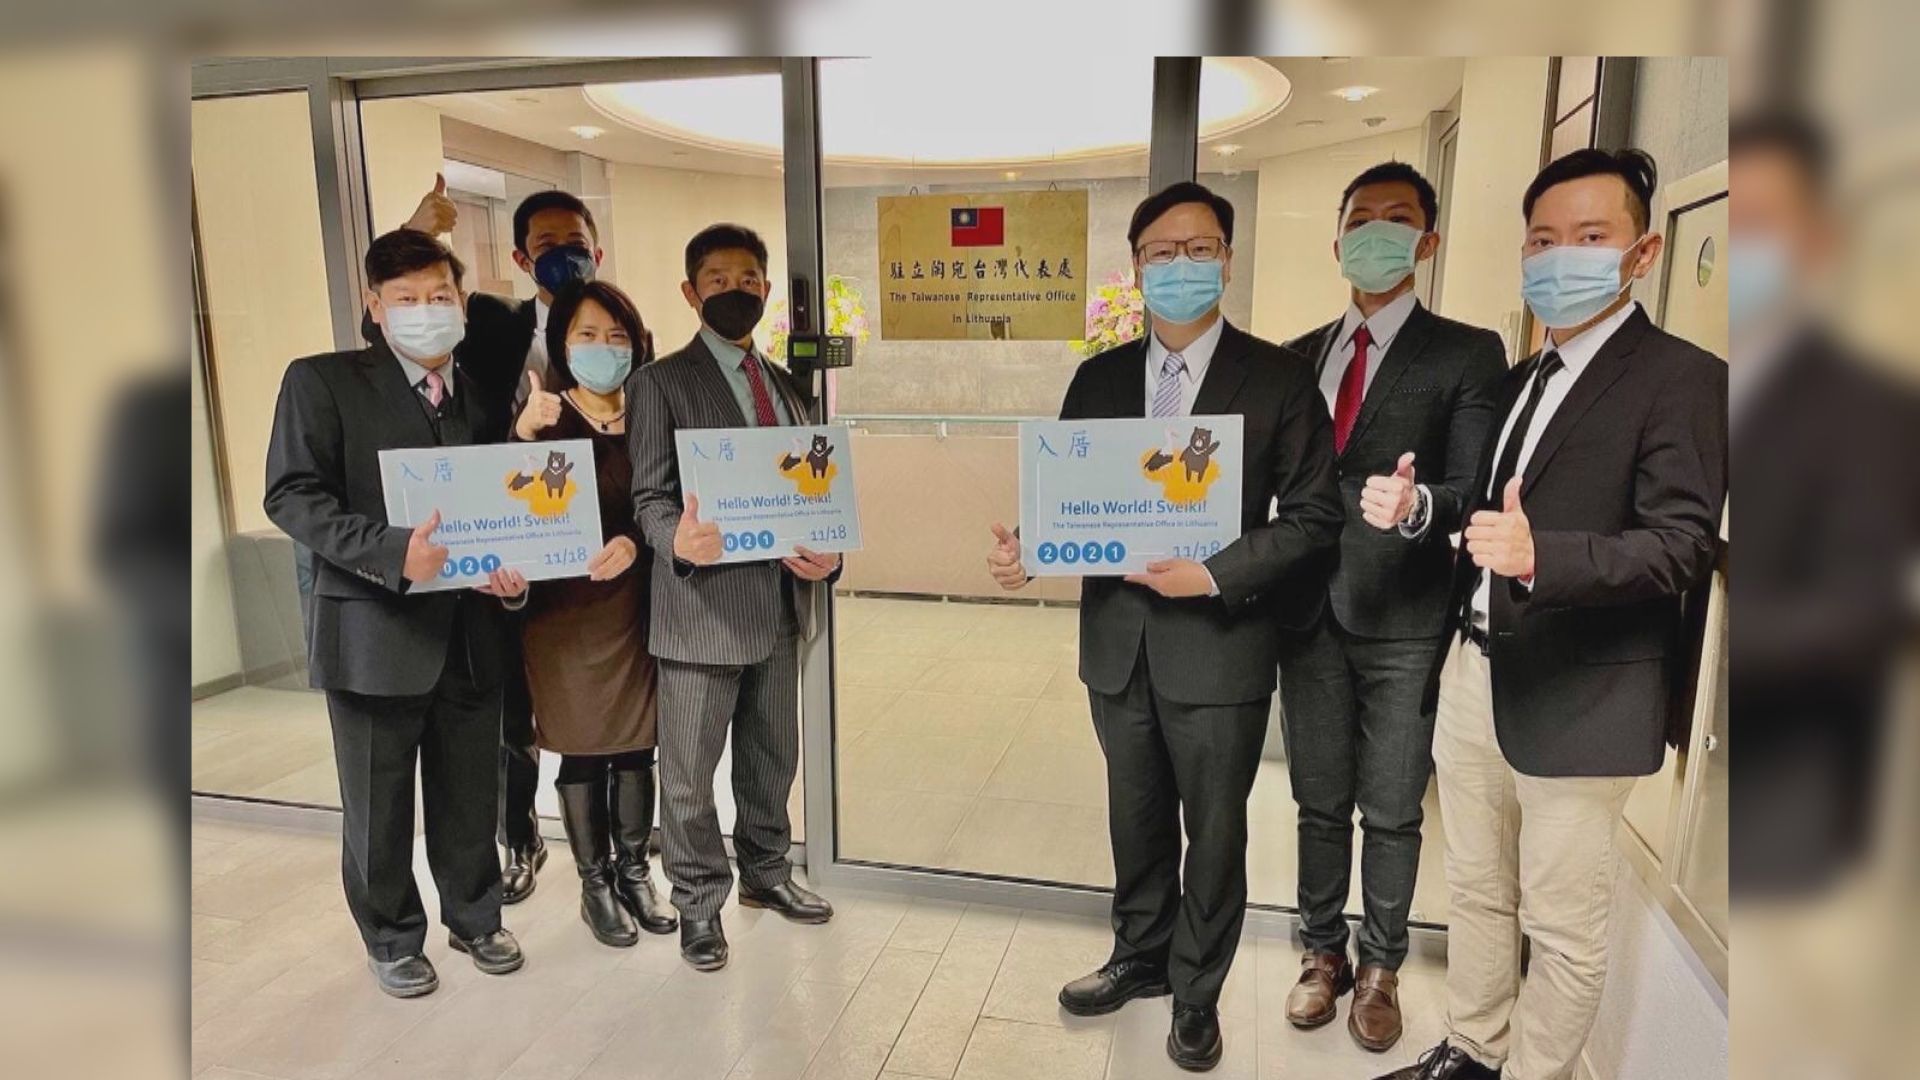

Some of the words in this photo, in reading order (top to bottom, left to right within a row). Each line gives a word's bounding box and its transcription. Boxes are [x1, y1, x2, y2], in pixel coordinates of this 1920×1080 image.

[889, 292, 907, 301] The
[911, 292, 960, 302] Taiwanese
[967, 291, 1041, 302] Representative
[1045, 290, 1076, 301] Office
[966, 313, 1012, 324] Lithuania
[718, 497, 750, 510] Hello
[751, 494, 790, 508] World!
[1061, 501, 1099, 516] Hello
[1103, 499, 1152, 515] World!
[473, 515, 521, 531] World!
[1053, 521, 1065, 530] The
[1066, 521, 1101, 530] Taiwanese
[1155, 519, 1176, 529] Office
[725, 532, 771, 550] 021
[811, 523, 847, 543] 11/18
[1041, 543, 1122, 563] 2021
[441, 556, 497, 577] 021
[544, 546, 587, 568] 11/18
